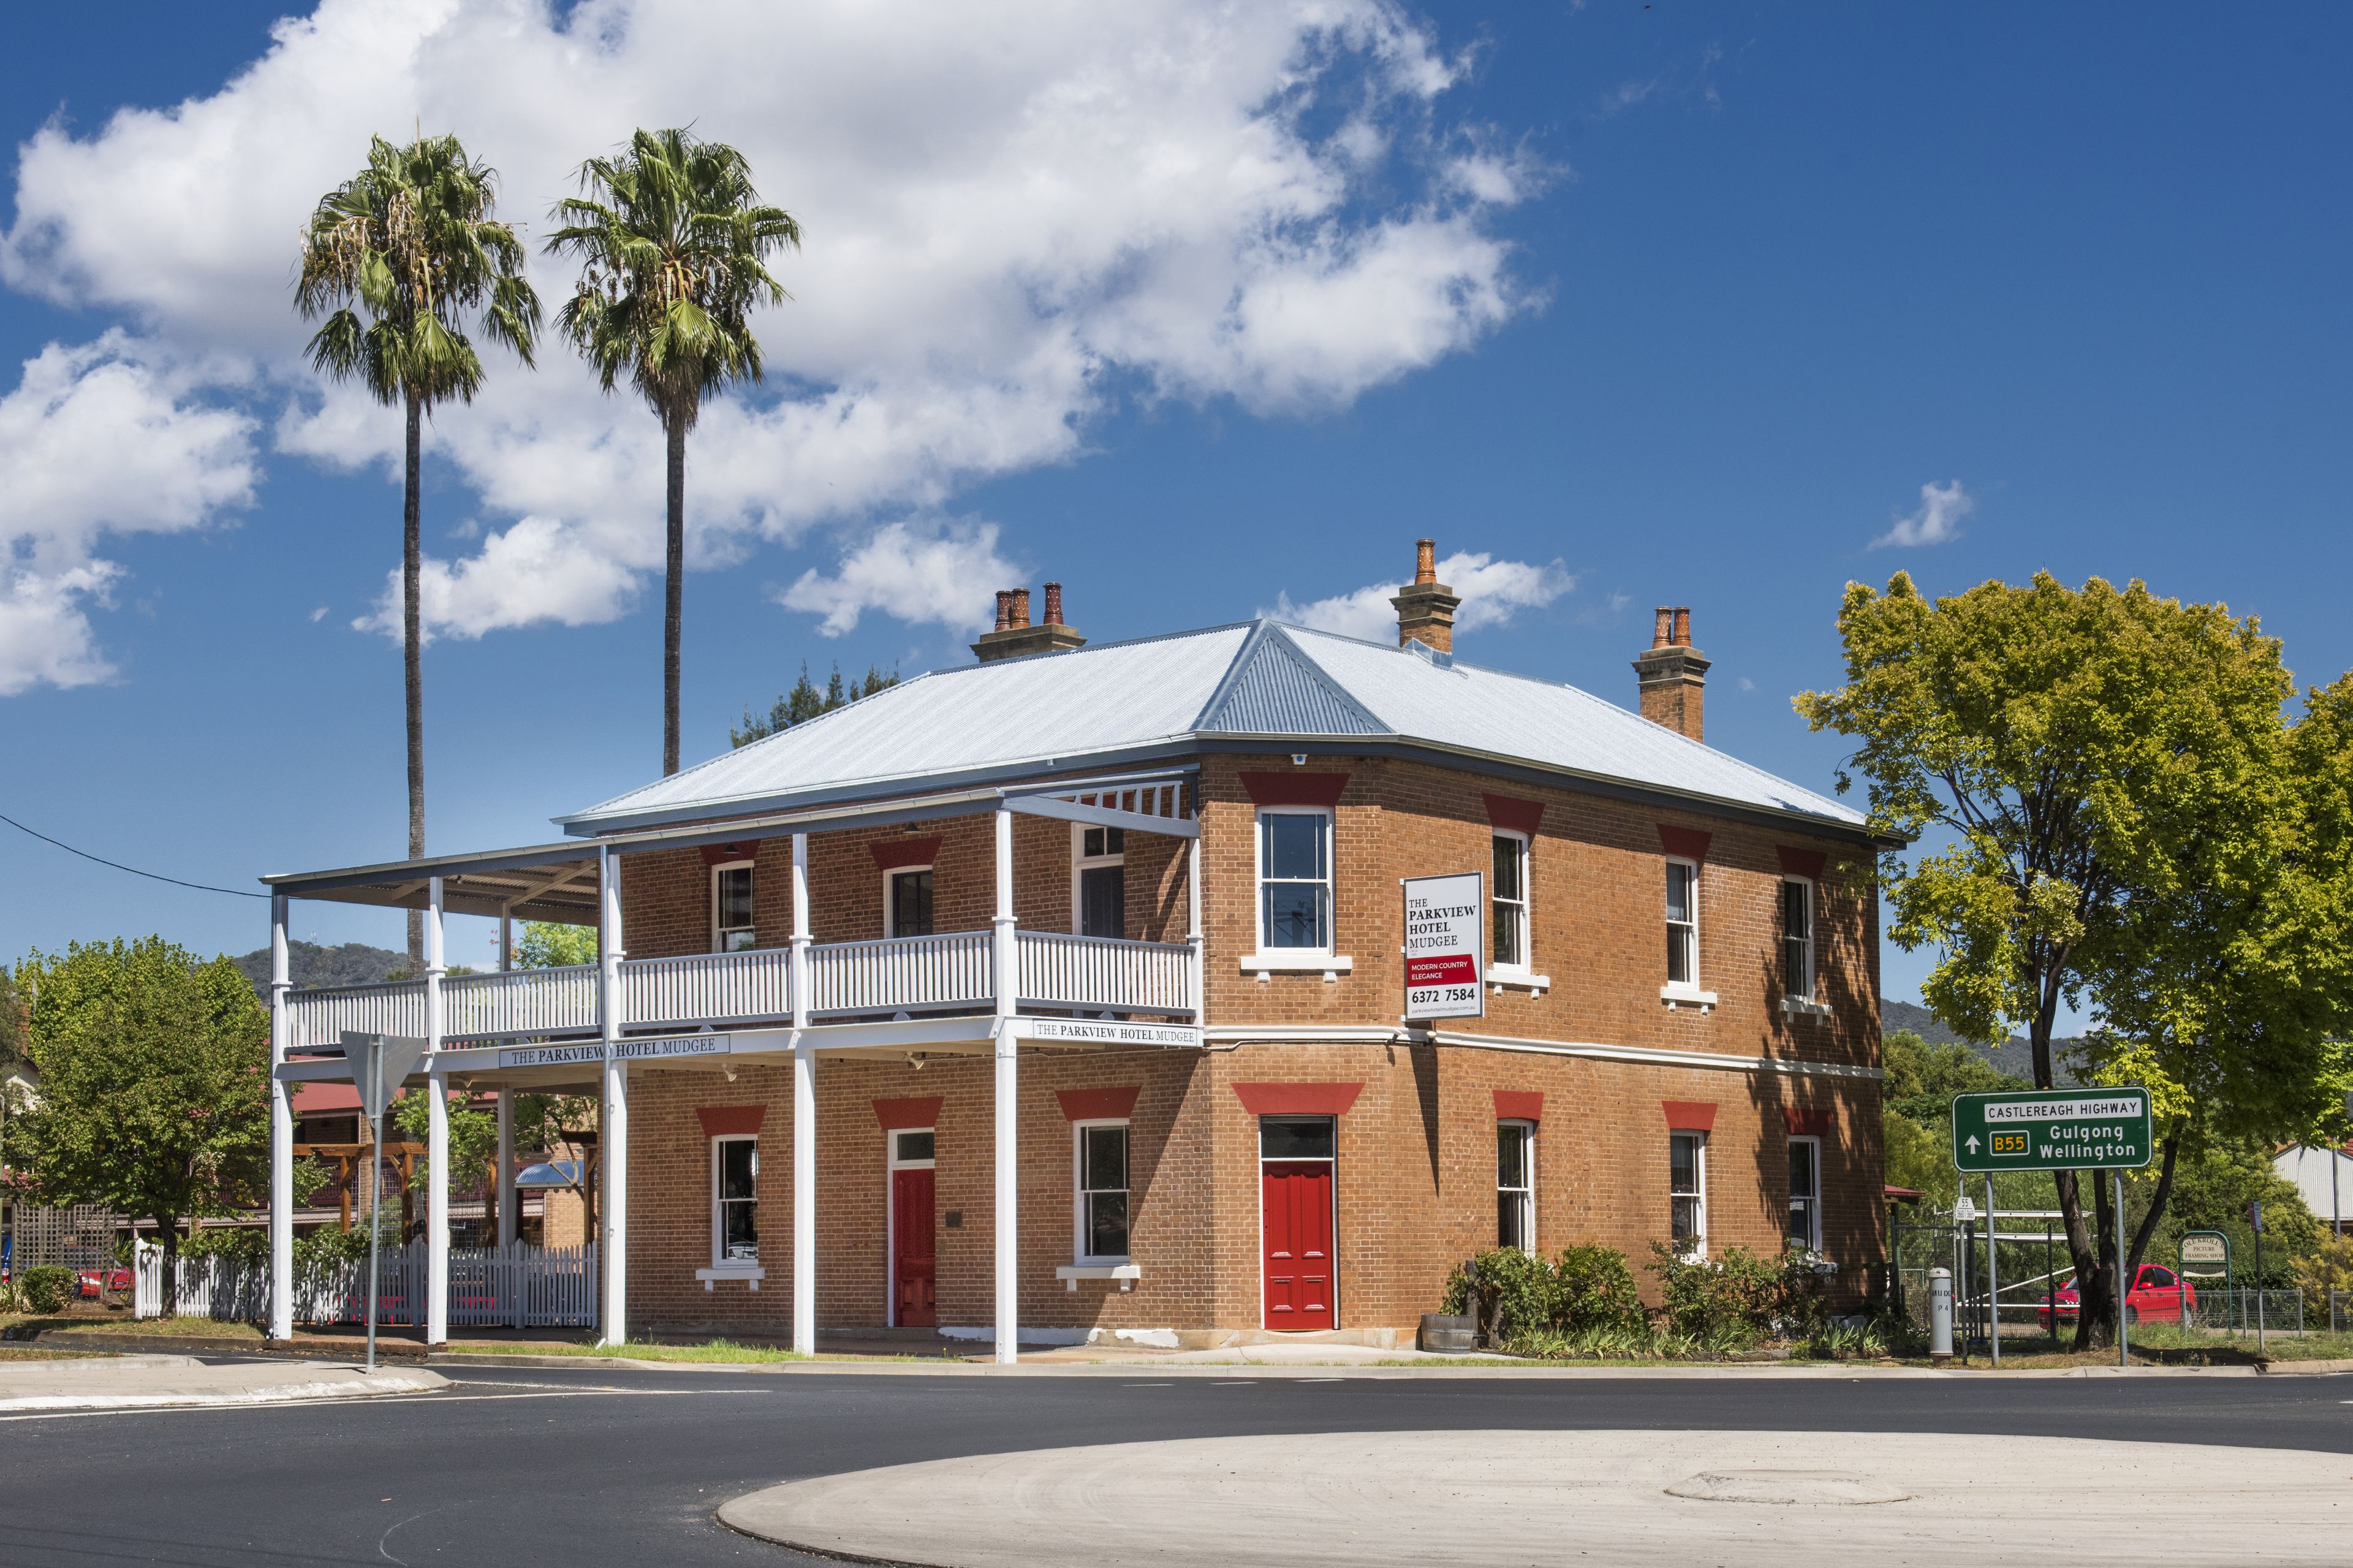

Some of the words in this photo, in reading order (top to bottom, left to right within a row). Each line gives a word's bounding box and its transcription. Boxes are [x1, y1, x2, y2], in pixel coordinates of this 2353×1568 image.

[1409, 898, 1428, 908] THE
[1409, 905, 1476, 920] PARKVIEW
[1409, 922, 1451, 934] HOTEL
[1409, 935, 1458, 949] MUDGEE
[1412, 990, 1439, 1004] 6372
[1446, 988, 1476, 1001] 7584
[1412, 1006, 1476, 1014] parkviewhotelmudgee.com.au
[1037, 1024, 1058, 1036] THE
[1060, 1025, 1116, 1039] PARKVIEW
[1120, 1029, 1154, 1040] HOTEL
[1156, 1031, 1194, 1042] MUDGEE
[512, 1050, 535, 1064] THE
[538, 1045, 604, 1062] PARKVIEW
[616, 1042, 660, 1057] HOTEL
[662, 1038, 716, 1053] MUDGEE
[1988, 1104, 2074, 1118] CASTLEREAGH
[2080, 1102, 2138, 1115] HIGHWAY
[2050, 1125, 2124, 1142] Gulgong
[1995, 1137, 2025, 1151] B55
[2040, 1142, 2135, 1161] Wellington
[1962, 1199, 1968, 1207] 55
[2183, 1239, 2197, 1248] OLE
[2198, 1237, 2224, 1249] KROLL'S
